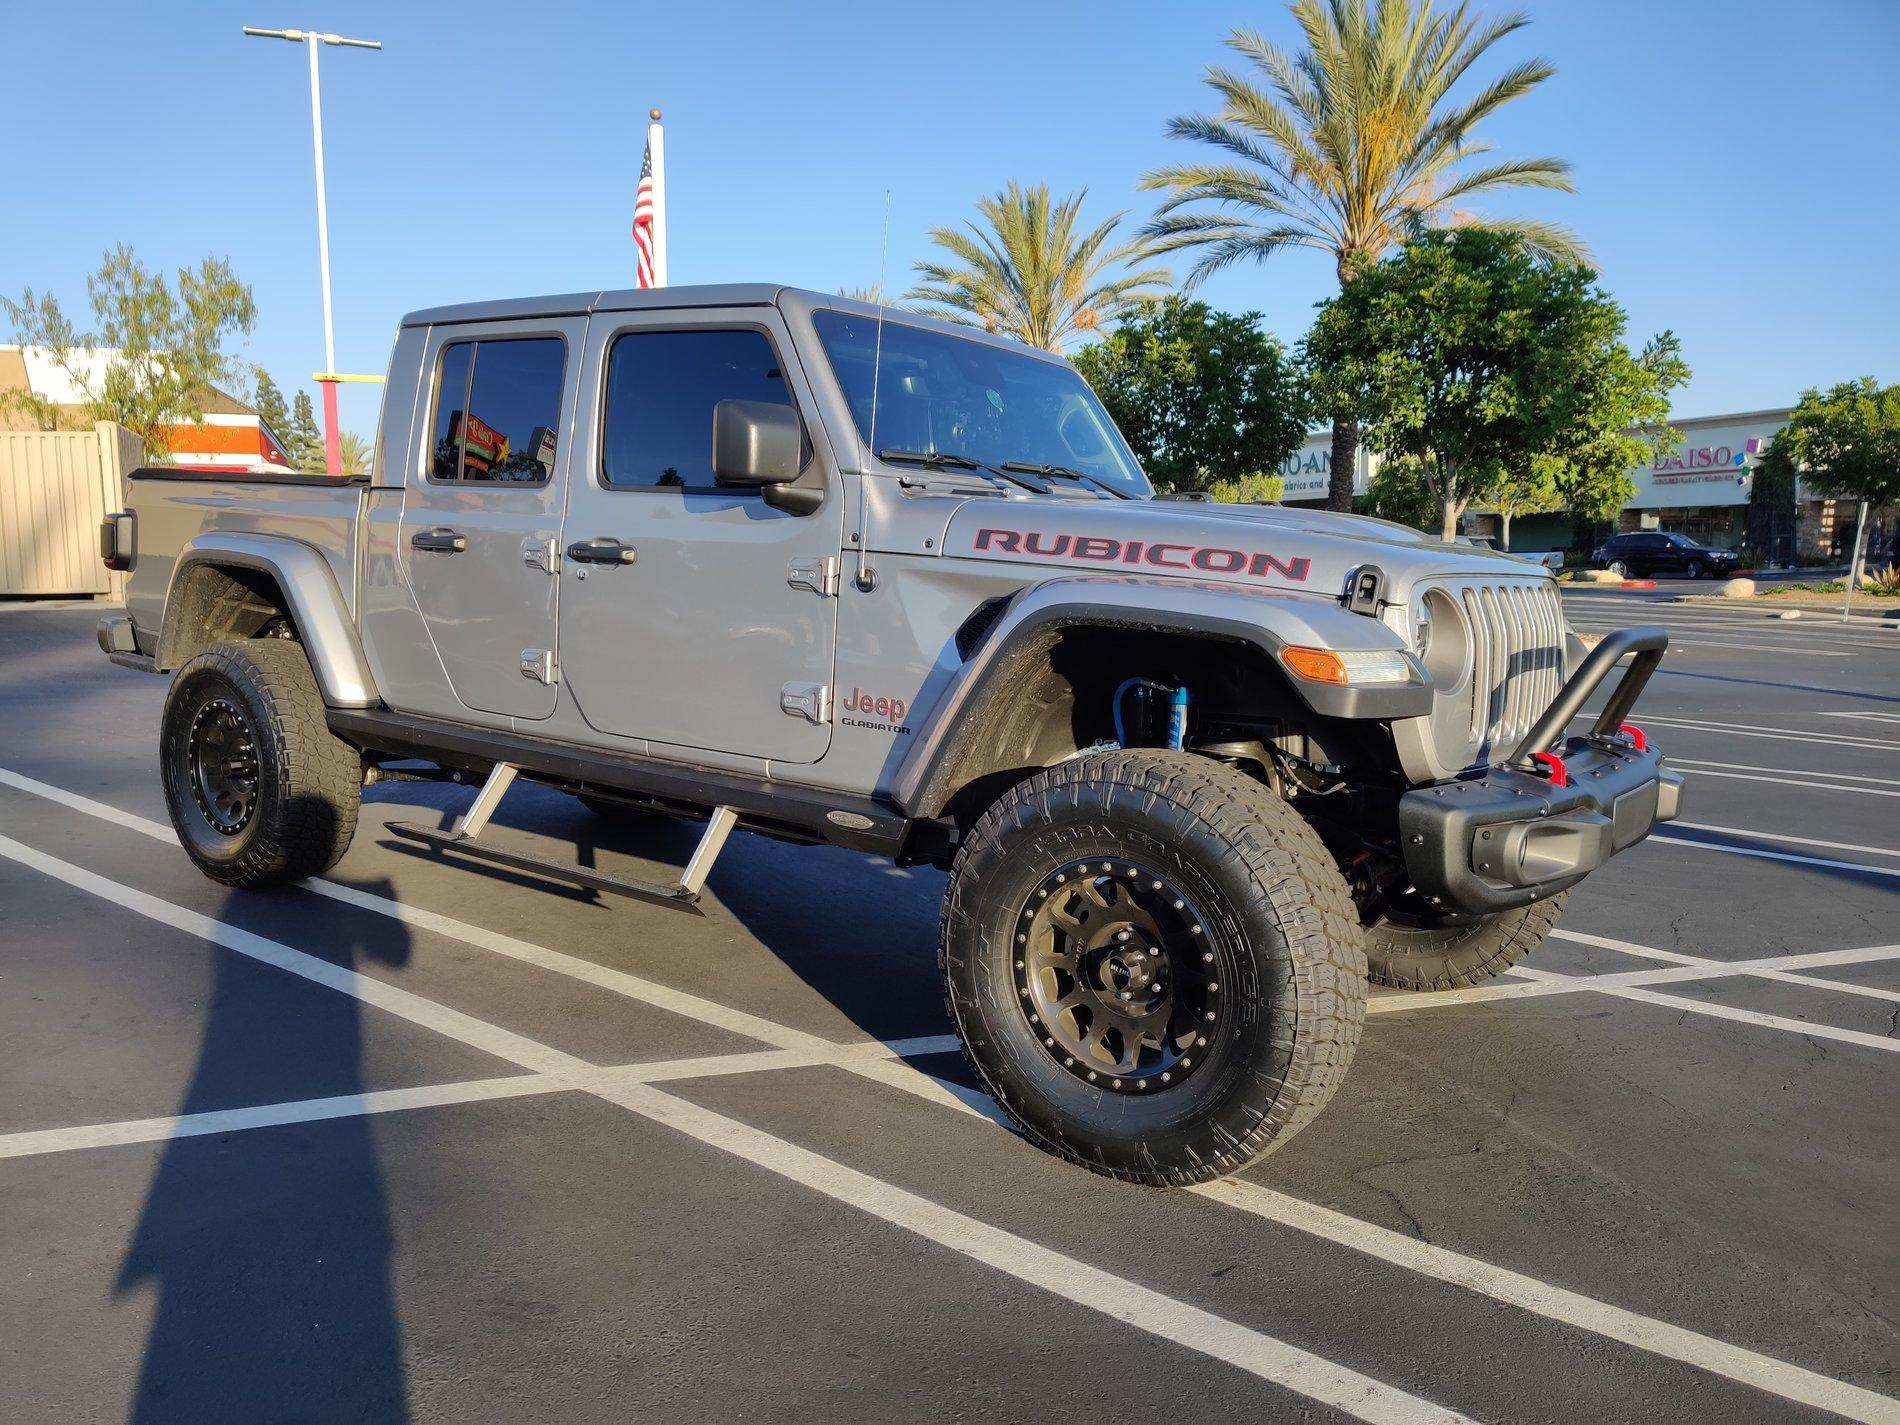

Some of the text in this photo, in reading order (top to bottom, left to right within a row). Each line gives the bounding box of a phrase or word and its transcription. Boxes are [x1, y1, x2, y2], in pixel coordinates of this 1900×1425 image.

[1284, 477, 1324, 490] abrics and
[973, 528, 1312, 582] RUBICON
[843, 687, 906, 722] Jeep
[841, 717, 911, 736] GLADIATOR
